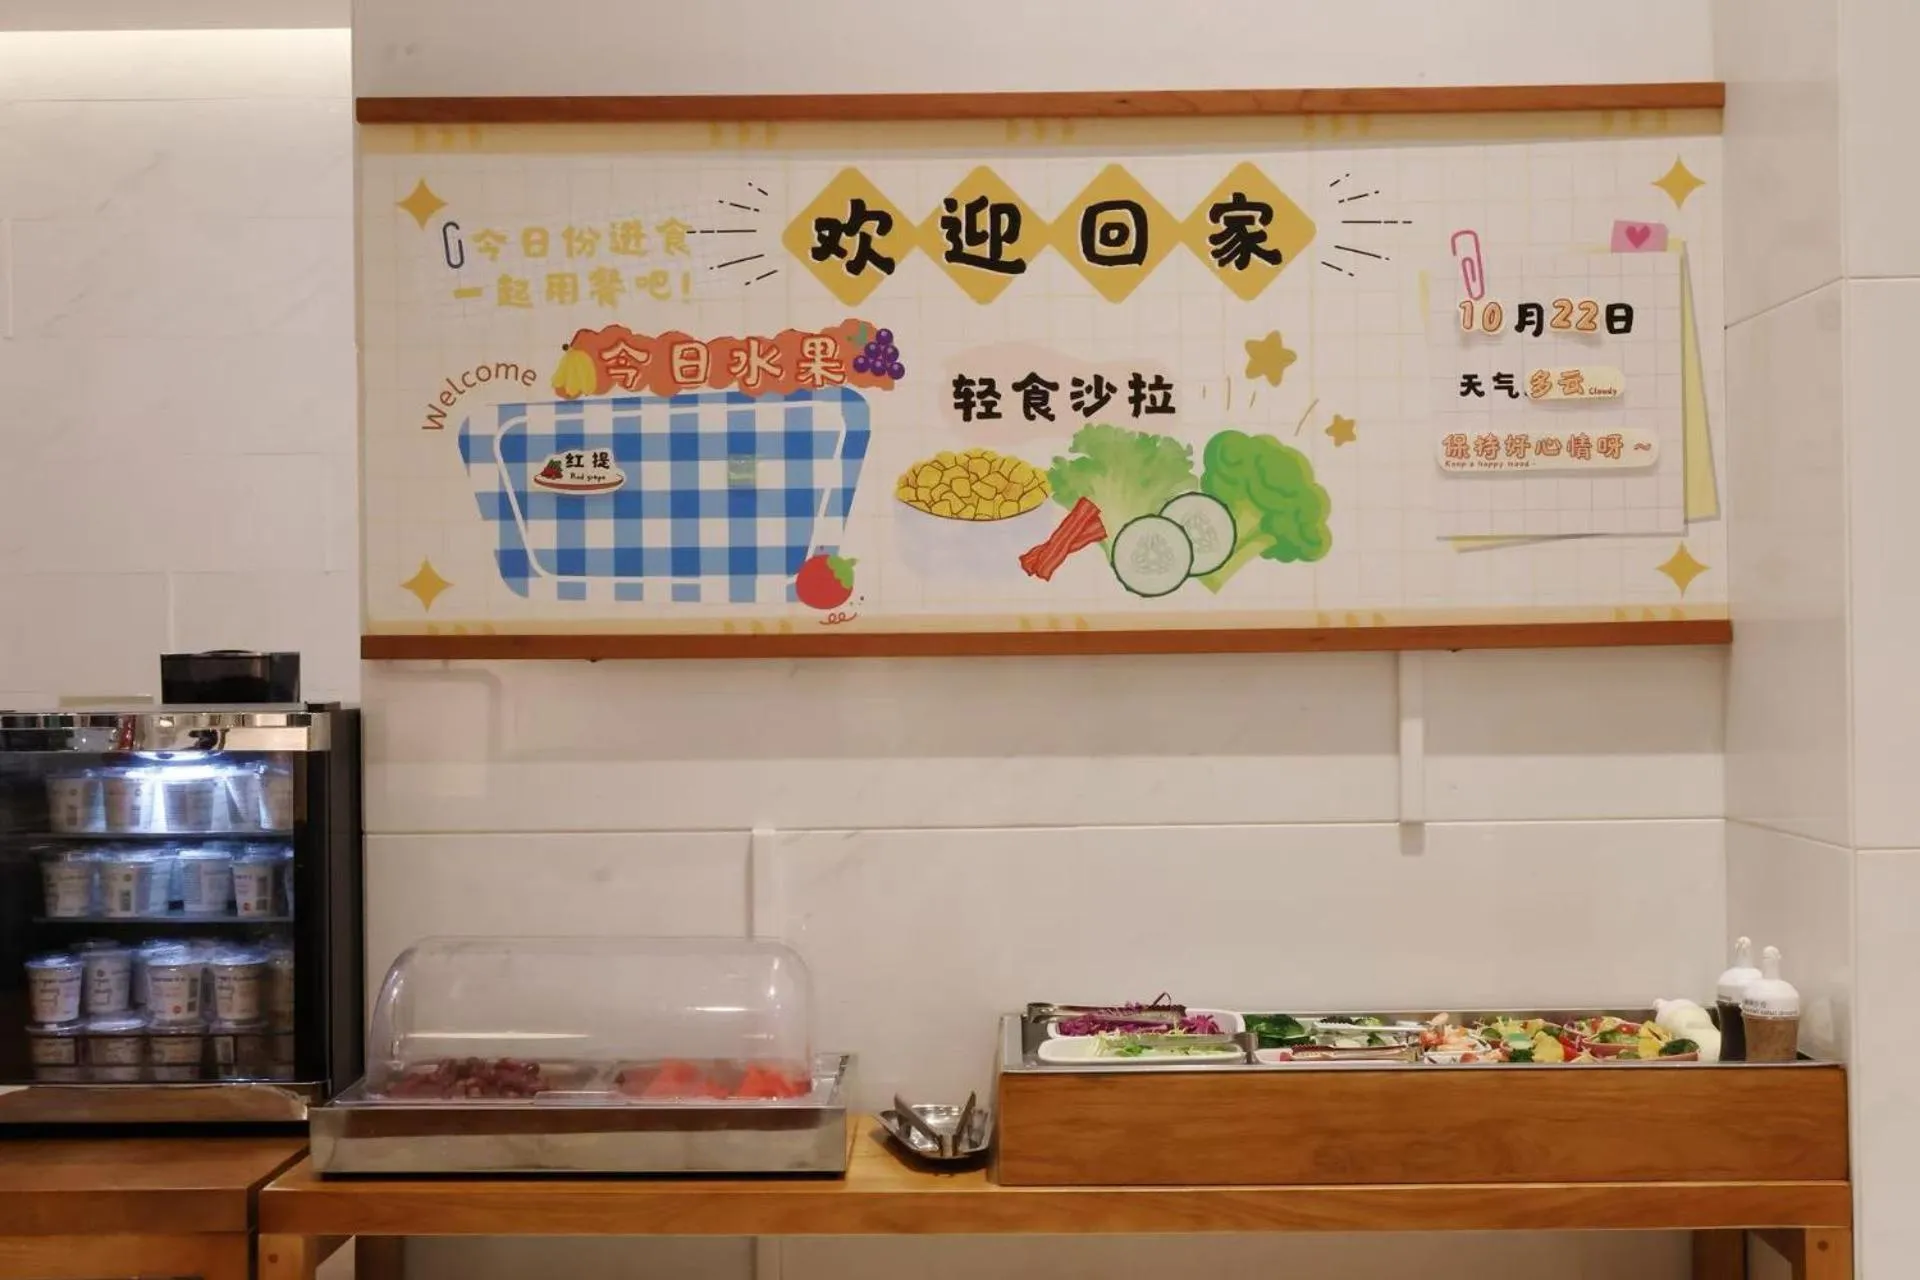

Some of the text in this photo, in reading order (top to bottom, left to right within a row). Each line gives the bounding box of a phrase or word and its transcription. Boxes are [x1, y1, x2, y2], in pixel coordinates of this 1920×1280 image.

[811, 192, 1283, 276] 欢迎回家
[599, 333, 847, 390] 今日水果
[421, 362, 537, 431] Welcome
[952, 371, 1176, 422] 轻食沙拉
[565, 452, 610, 470] 红提
